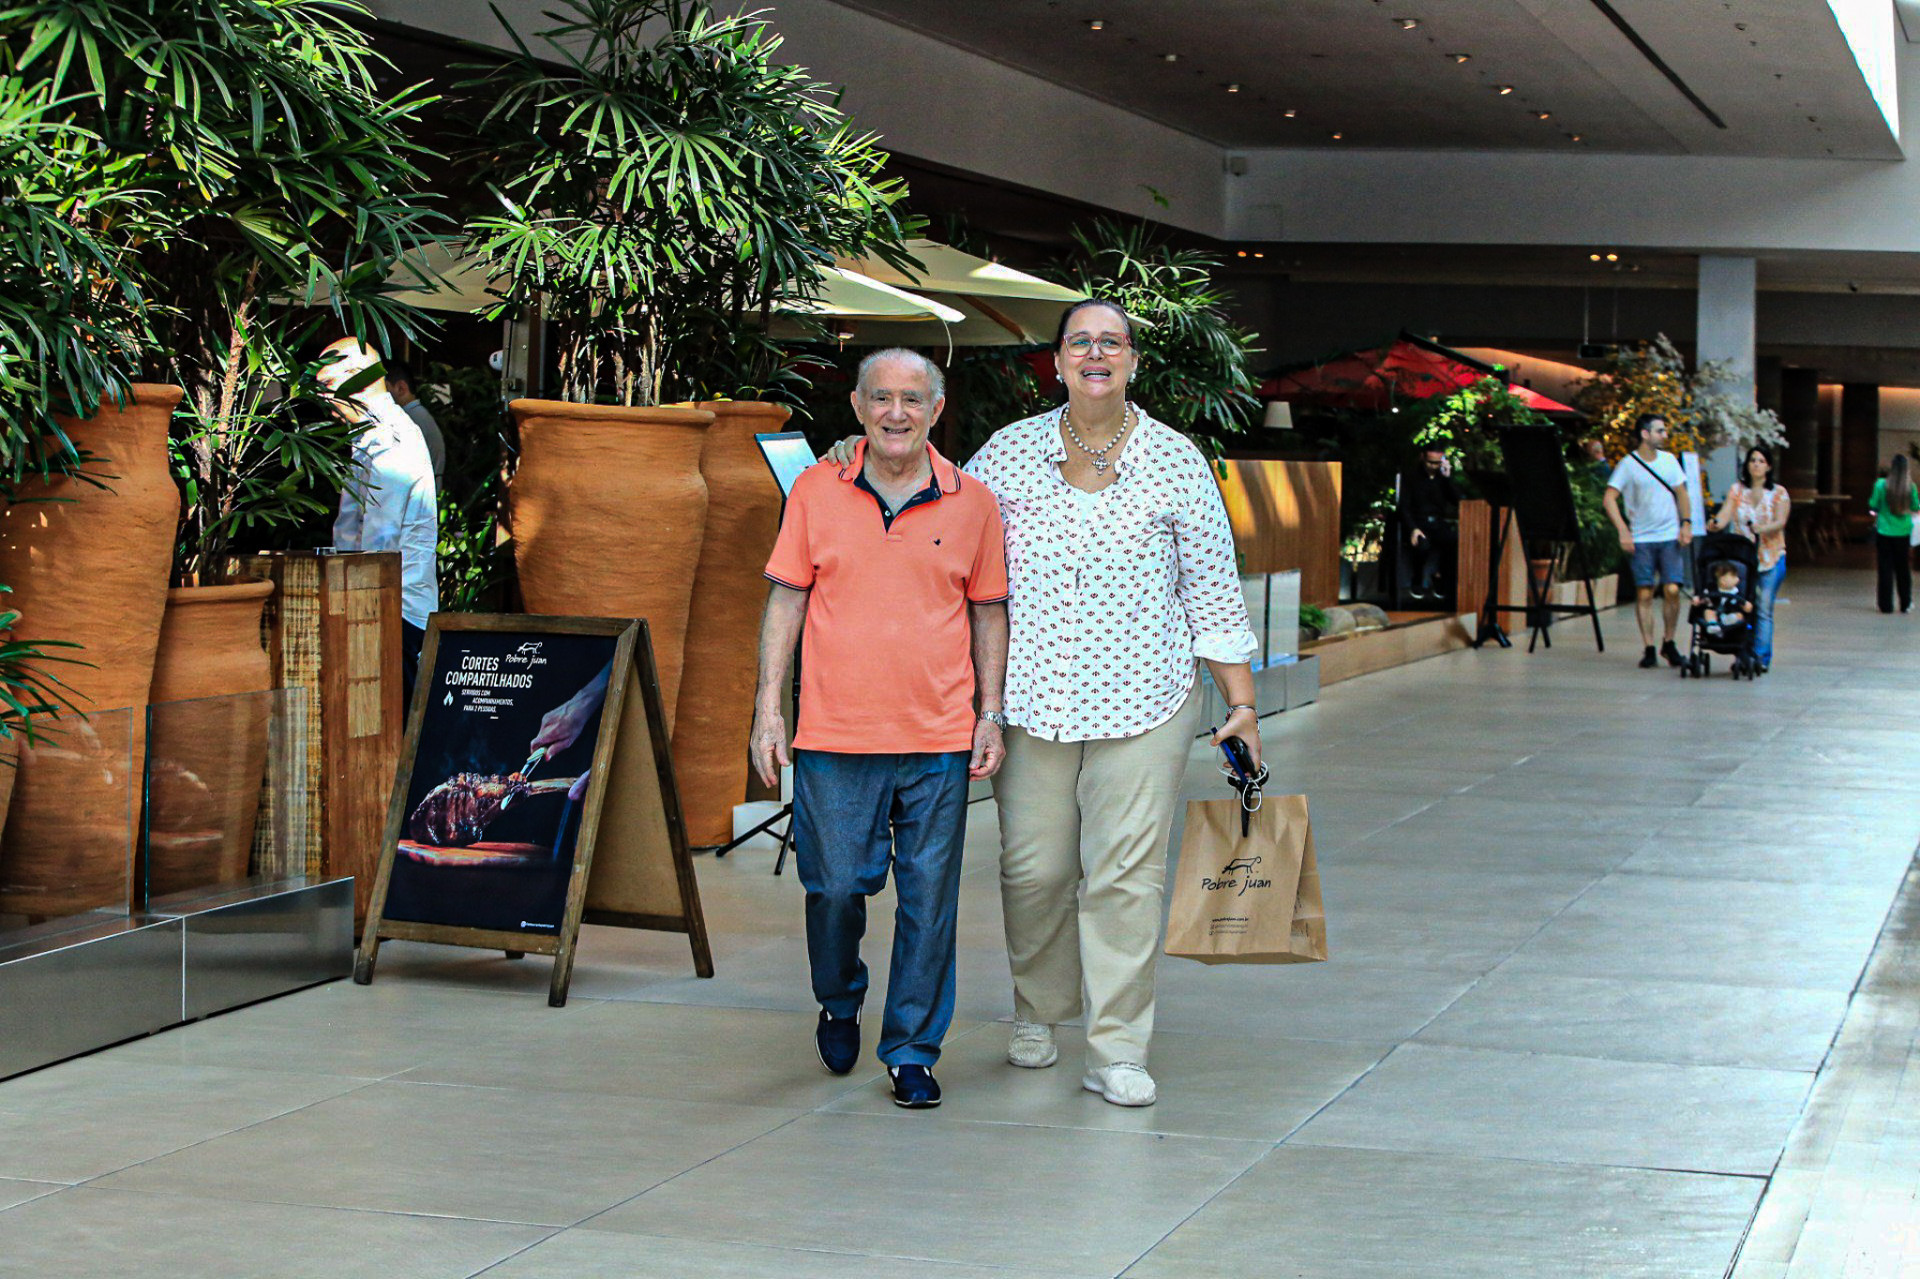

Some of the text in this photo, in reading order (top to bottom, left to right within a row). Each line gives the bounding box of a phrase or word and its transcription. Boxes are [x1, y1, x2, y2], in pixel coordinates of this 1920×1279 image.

[461, 656, 500, 671] CORTES
[505, 653, 547, 670] Pobre juan
[445, 671, 533, 688] COMPARTILHADOS
[1201, 875, 1272, 897] Pobre juan
